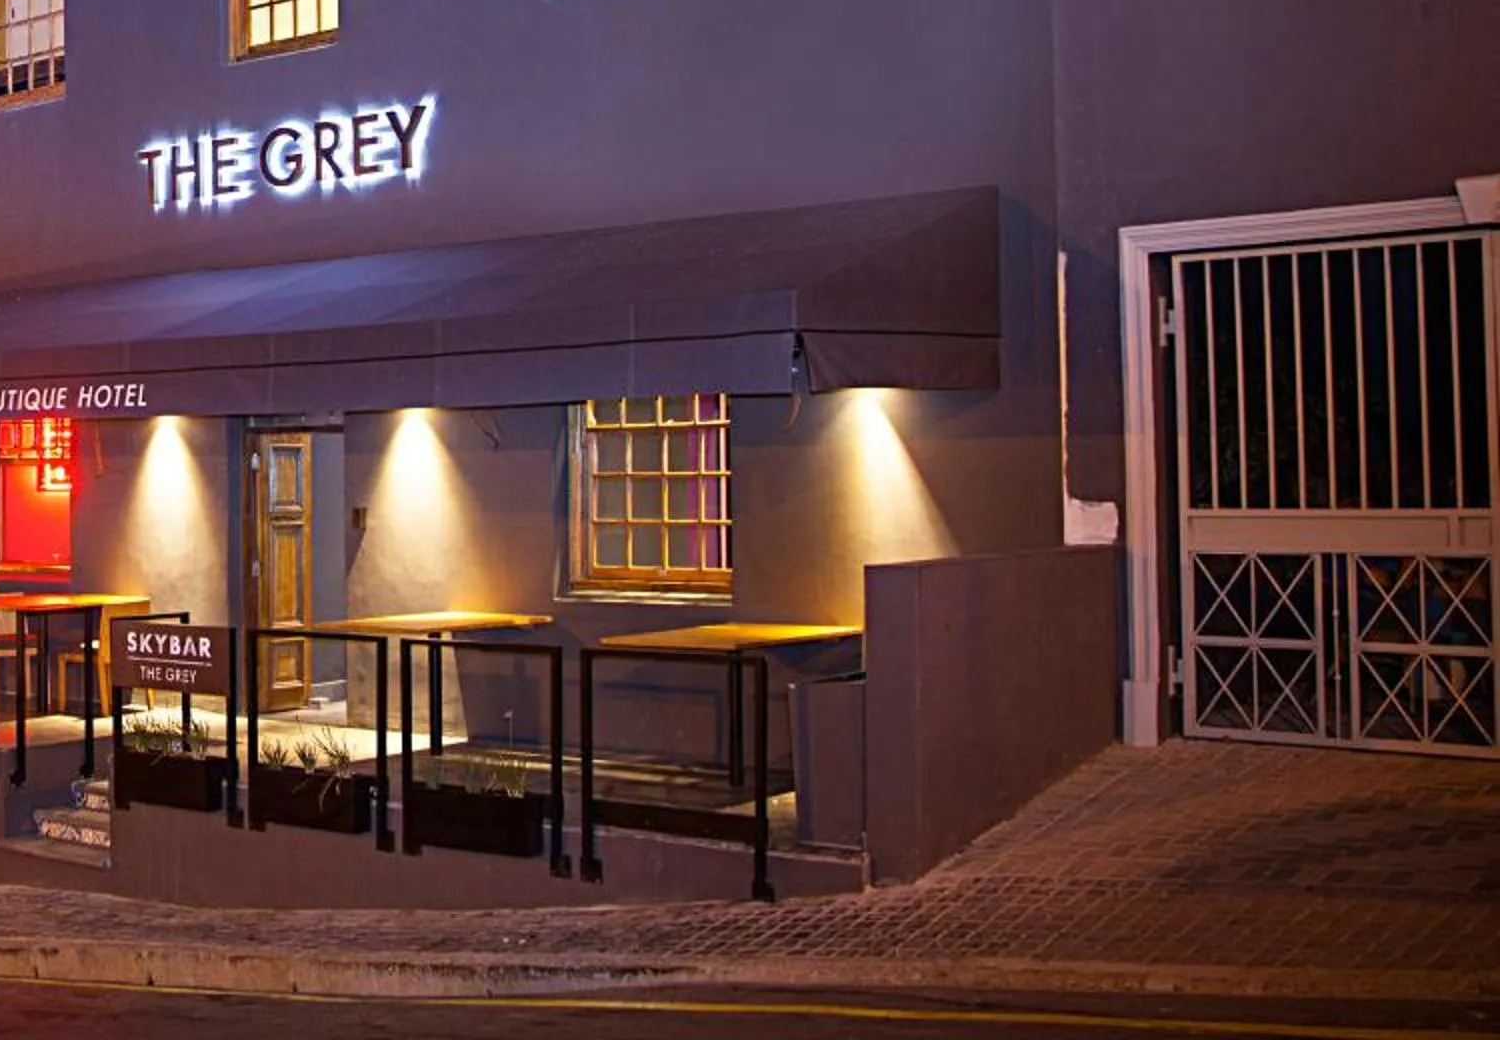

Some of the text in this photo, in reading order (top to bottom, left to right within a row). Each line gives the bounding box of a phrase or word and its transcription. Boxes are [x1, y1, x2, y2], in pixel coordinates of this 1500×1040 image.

[138, 102, 432, 208] THE GREY
[76, 383, 148, 409] HOTEL
[126, 631, 212, 658] SKYBAR
[140, 665, 197, 683] THE GREY
